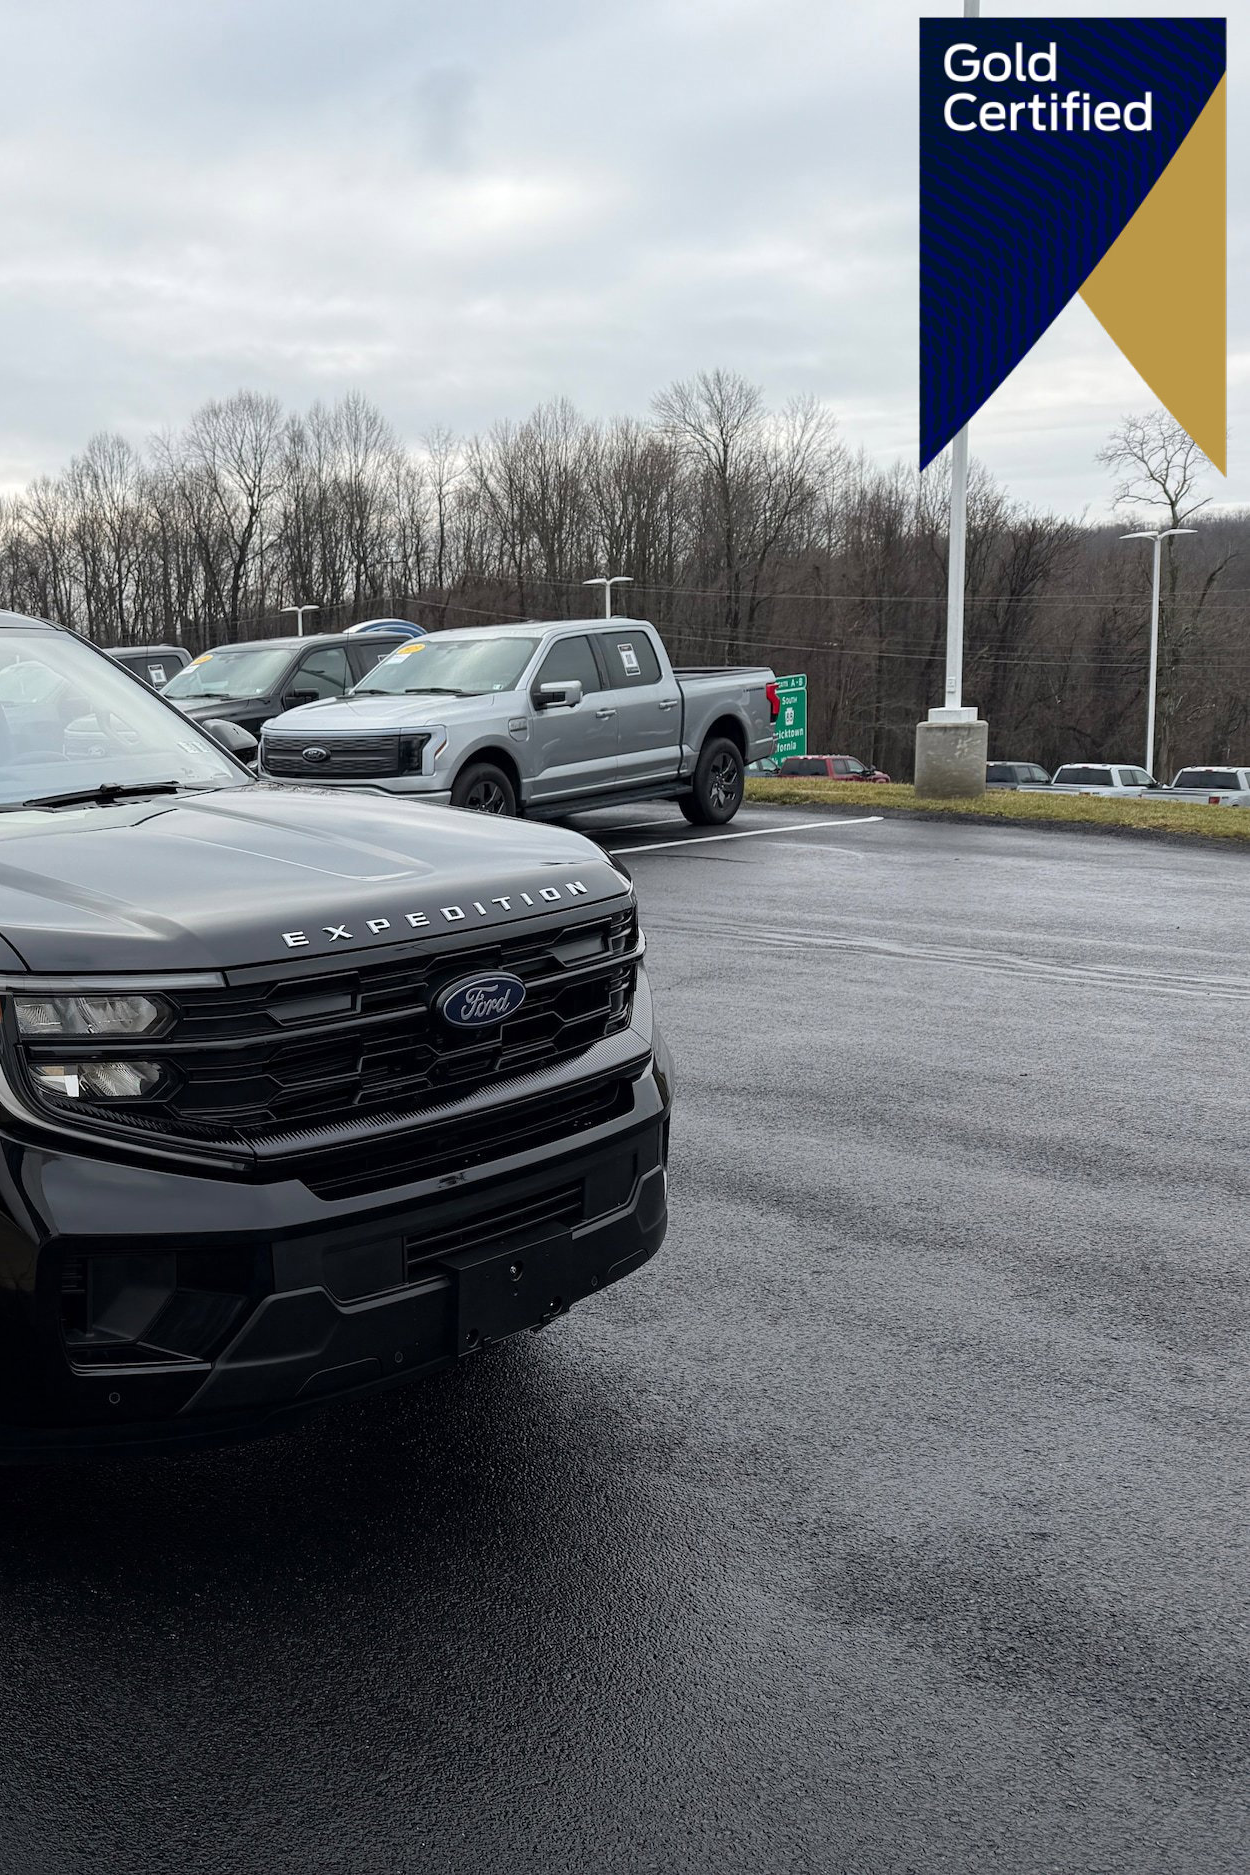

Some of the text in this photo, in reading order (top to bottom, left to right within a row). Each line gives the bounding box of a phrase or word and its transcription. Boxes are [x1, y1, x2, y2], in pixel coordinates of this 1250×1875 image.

[776, 740, 797, 753] fornia
[282, 880, 589, 948] EXPEDITION
[460, 984, 511, 1020] Ford
